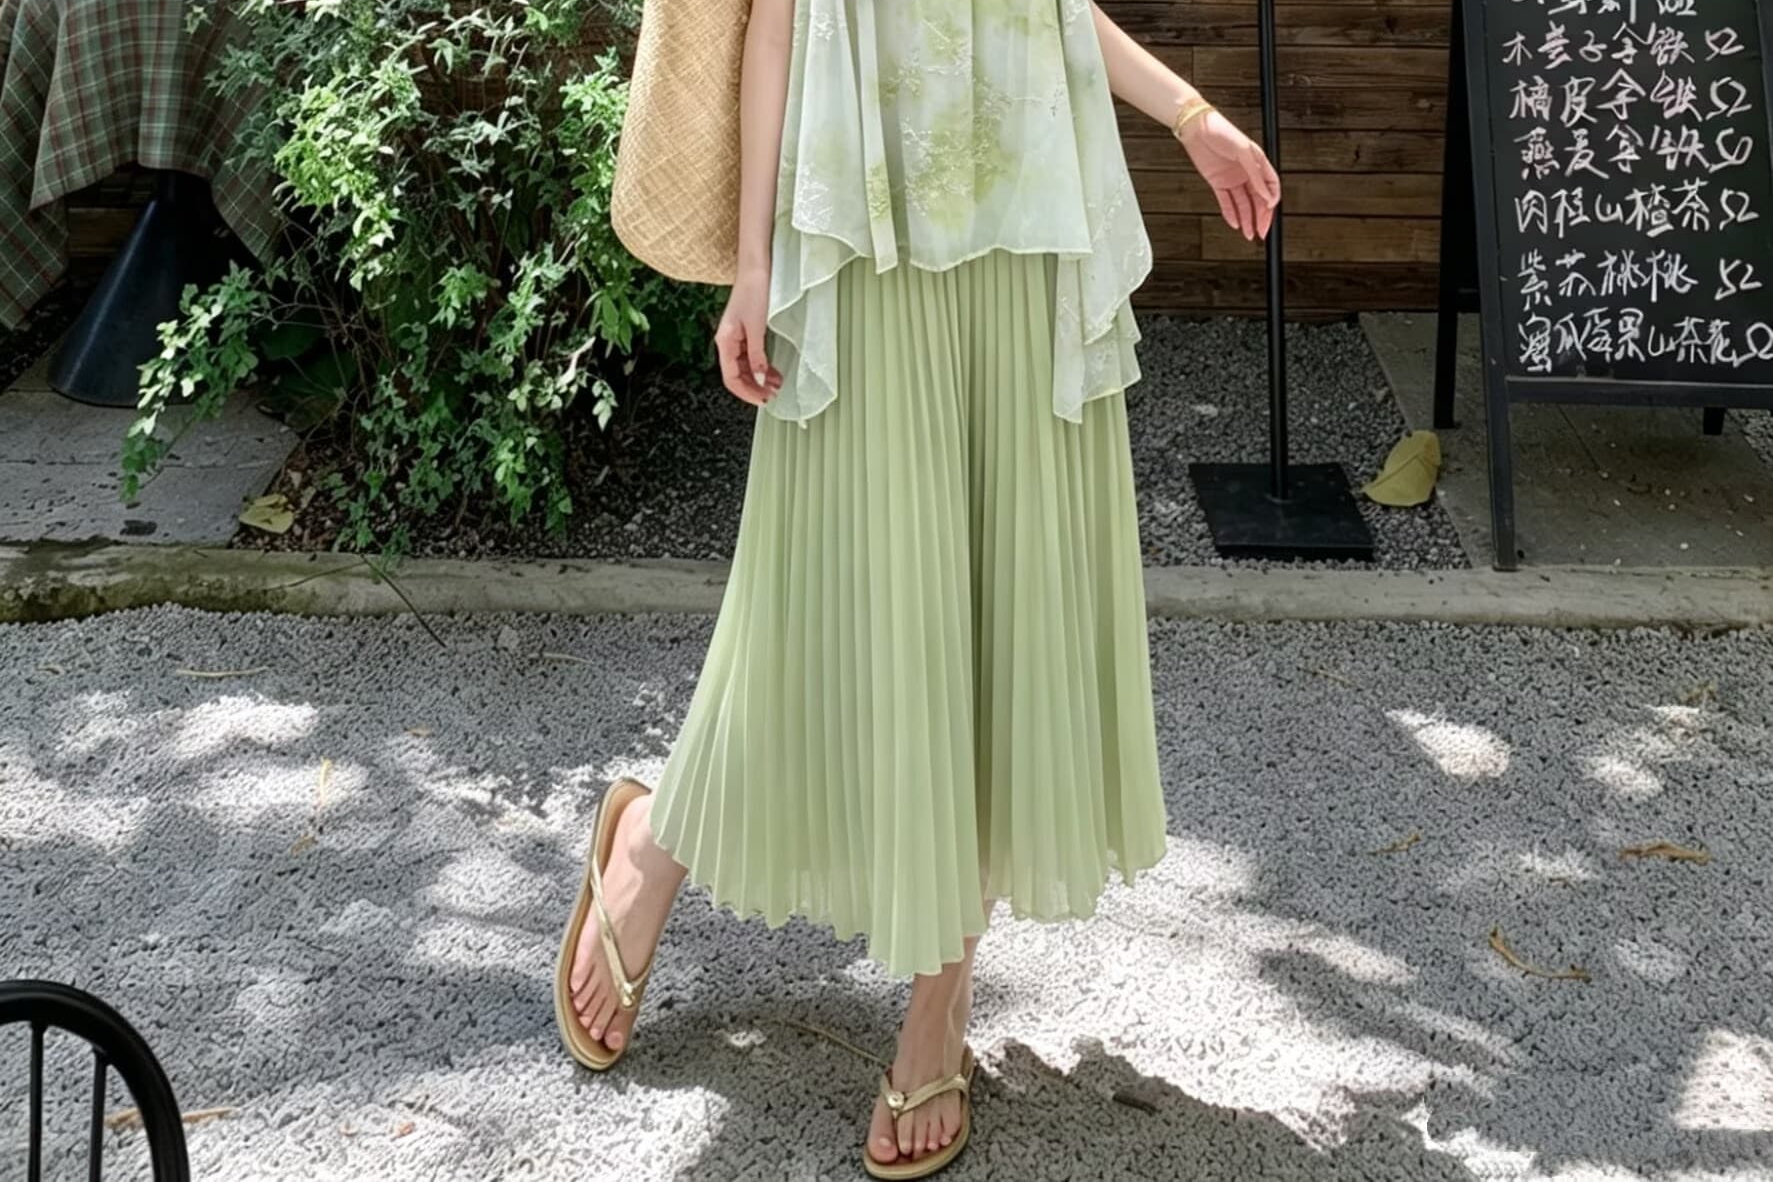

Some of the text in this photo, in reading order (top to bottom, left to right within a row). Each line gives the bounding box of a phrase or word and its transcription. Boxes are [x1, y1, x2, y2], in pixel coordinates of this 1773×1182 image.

[1514, 177, 1710, 239] 肉桂山楂茶
[1714, 258, 1763, 301] 52
